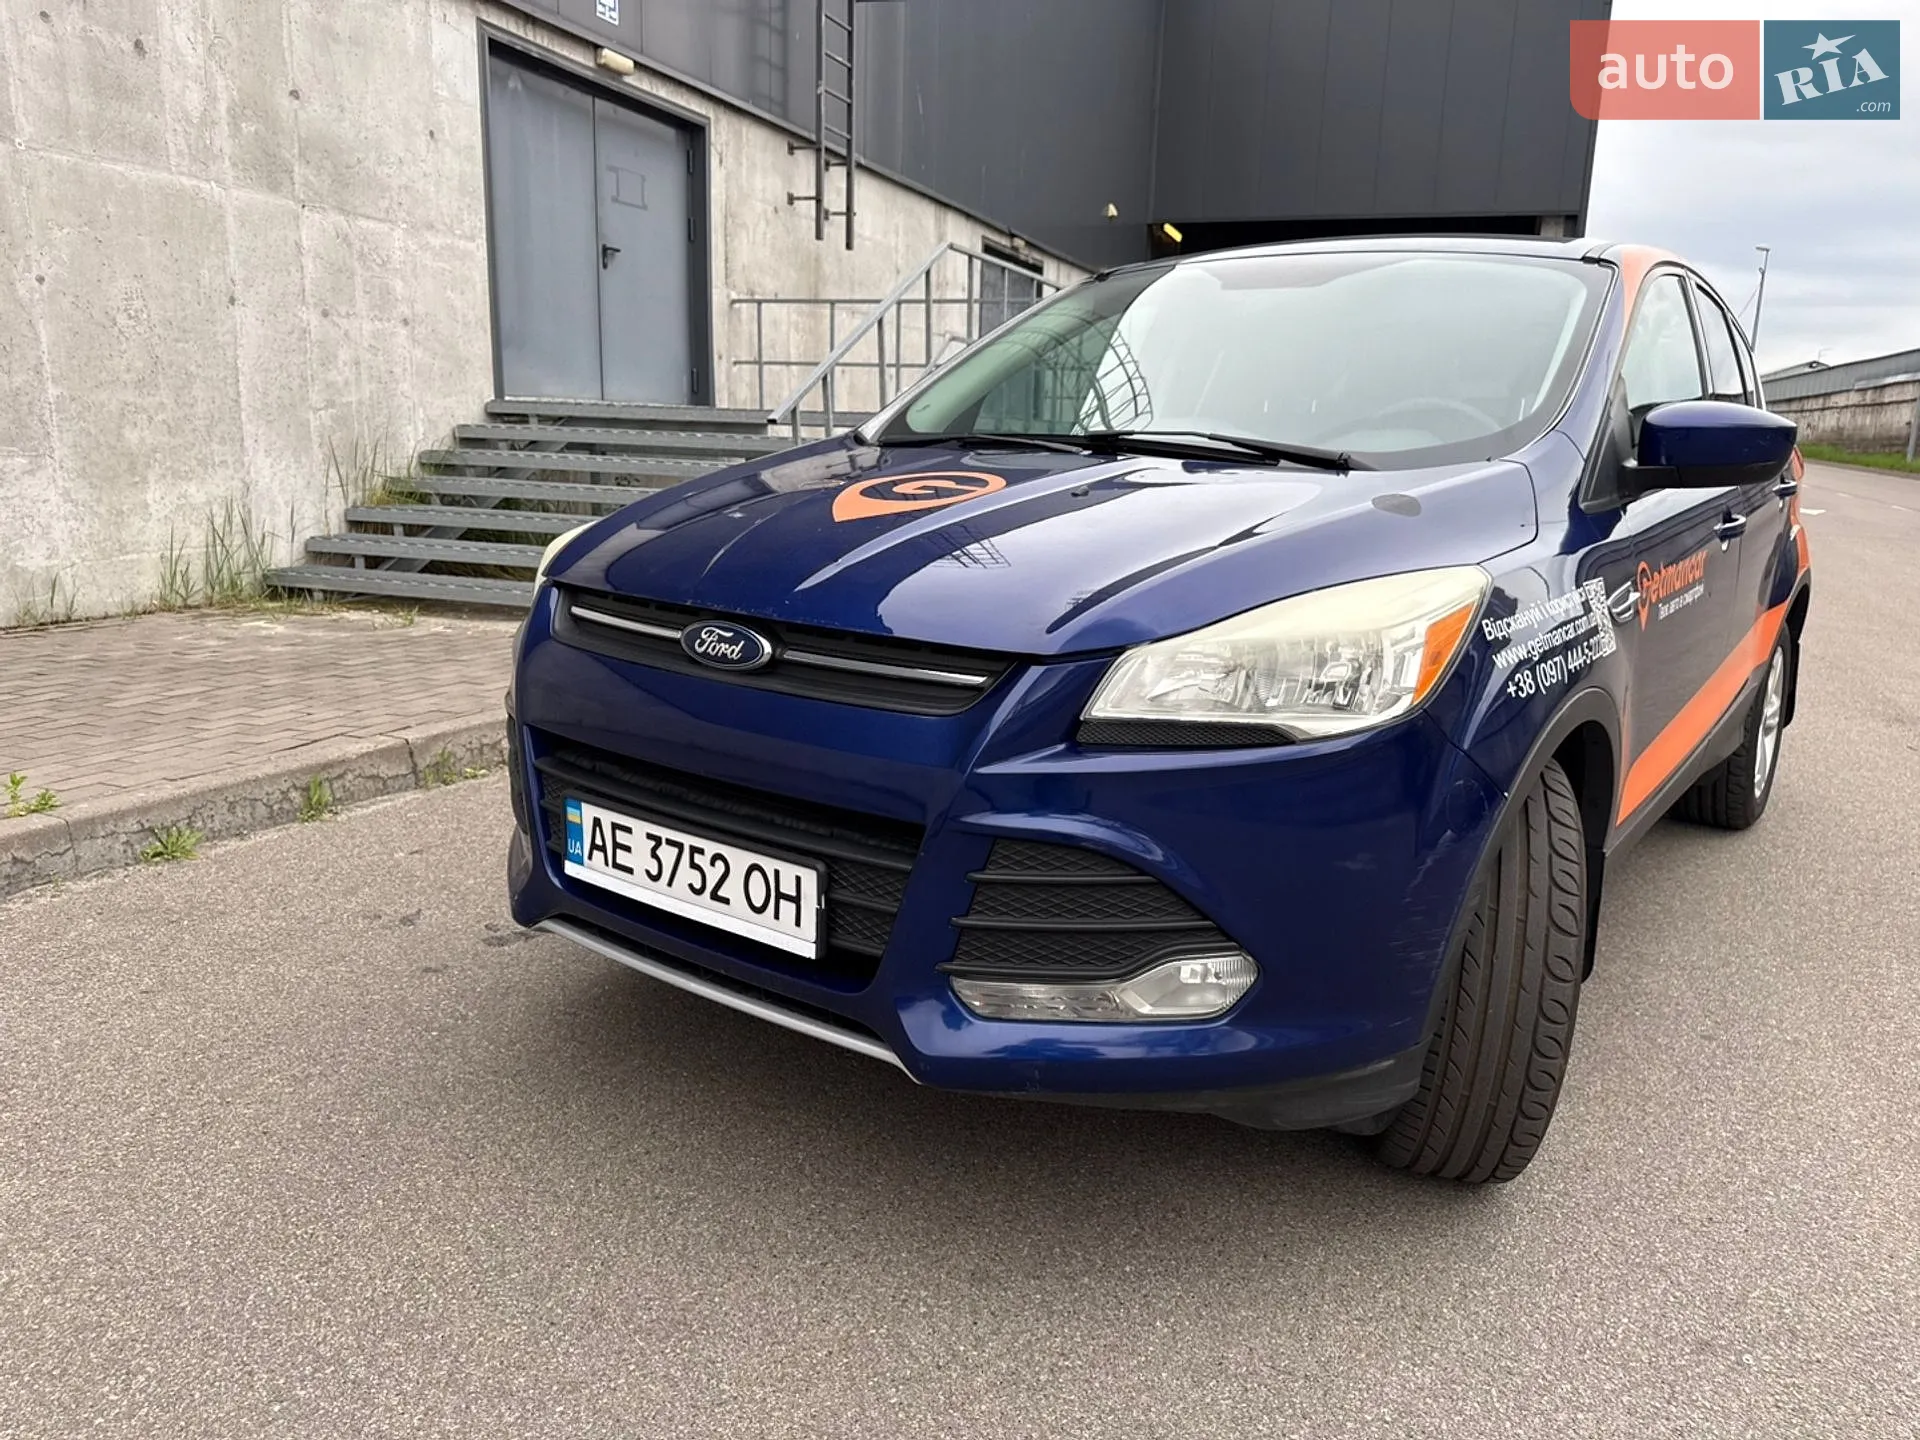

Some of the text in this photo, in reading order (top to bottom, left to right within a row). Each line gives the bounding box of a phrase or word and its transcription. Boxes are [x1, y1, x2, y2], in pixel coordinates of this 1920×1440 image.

[1482, 604, 1544, 641] Відскануй
[695, 626, 744, 660] Ford
[1507, 669, 1536, 698] +38
[1536, 655, 1568, 695] (097)
[567, 838, 583, 857] UA
[587, 816, 802, 928] AE 3752 OH
